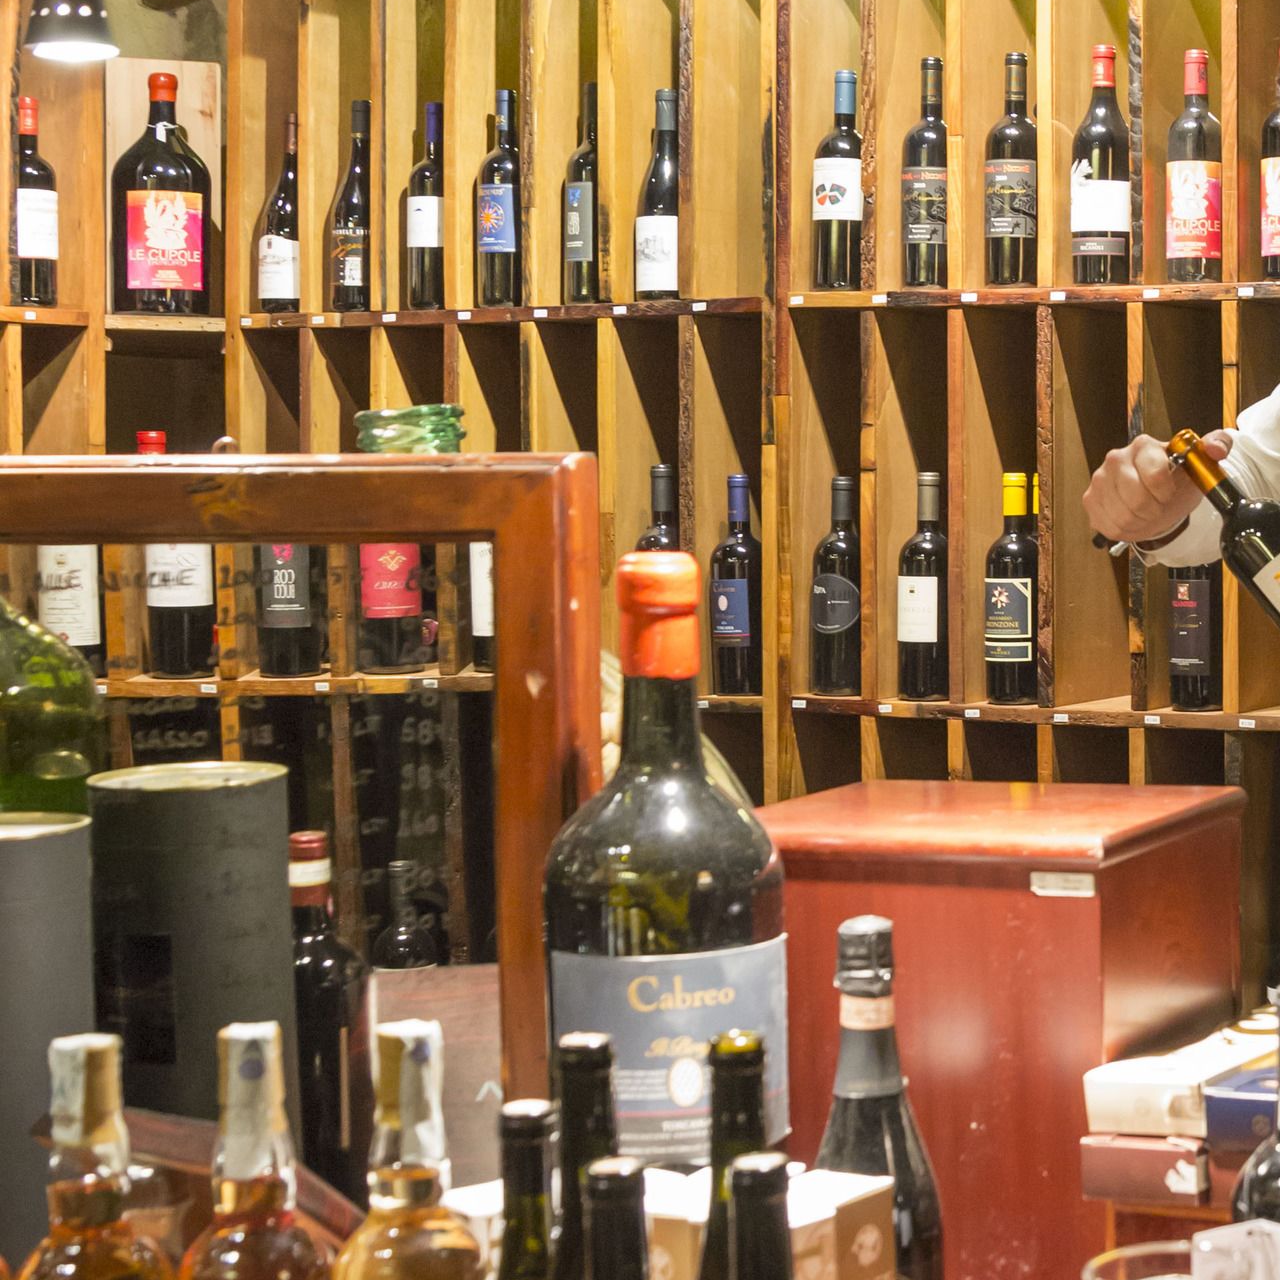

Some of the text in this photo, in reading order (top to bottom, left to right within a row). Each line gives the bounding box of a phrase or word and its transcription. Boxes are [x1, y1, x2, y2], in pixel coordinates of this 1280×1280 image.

[129, 248, 202, 263] LE CUPOLE
[627, 974, 737, 1013] Cabreo
